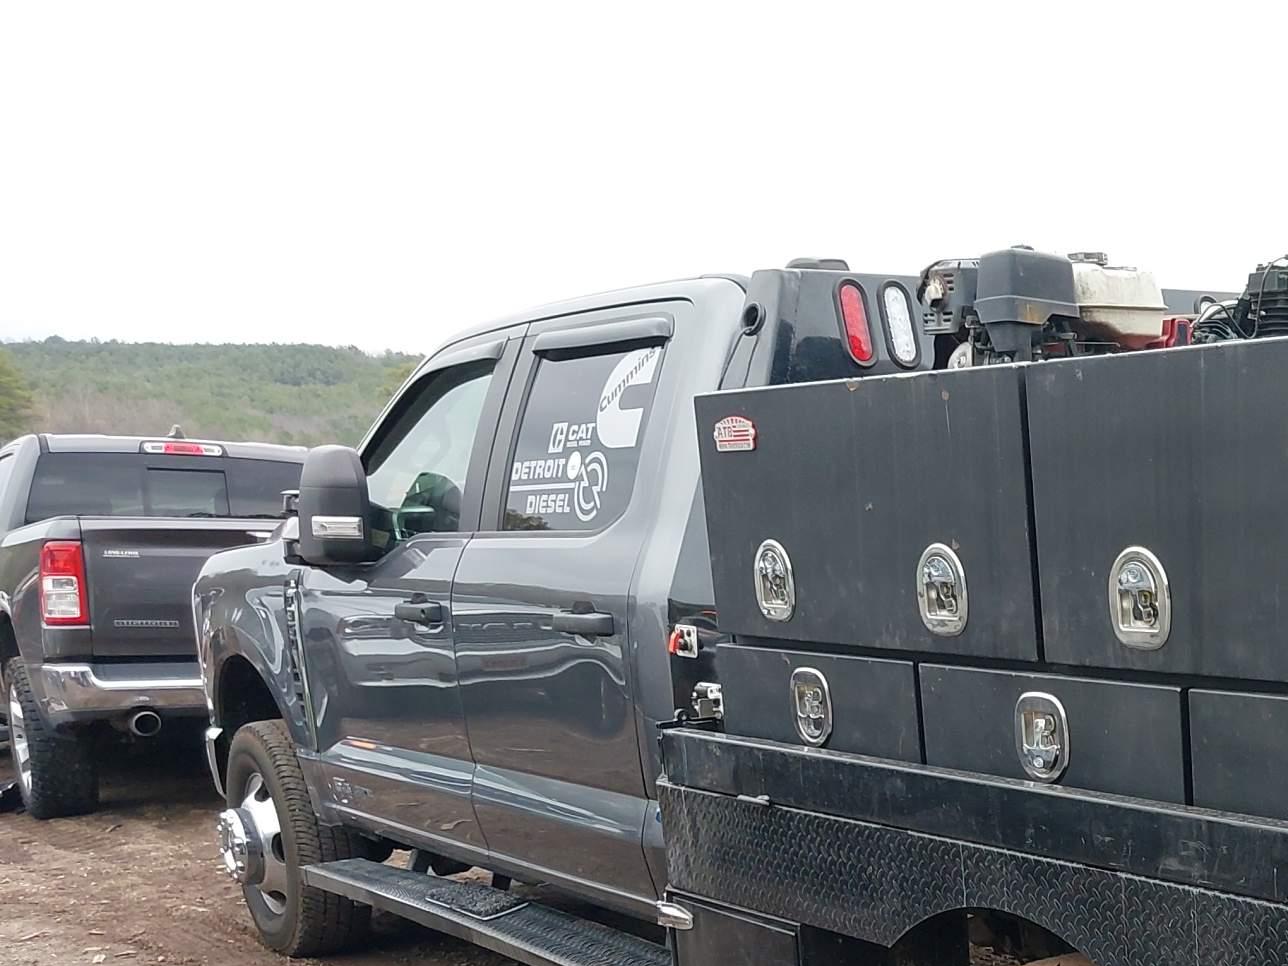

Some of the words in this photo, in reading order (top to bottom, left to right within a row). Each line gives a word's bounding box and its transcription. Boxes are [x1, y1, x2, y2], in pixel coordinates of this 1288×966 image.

[600, 349, 656, 412] Cummins
[569, 422, 596, 441] CAT
[511, 459, 566, 481] DETROIT
[526, 493, 571, 514] DIESEL
